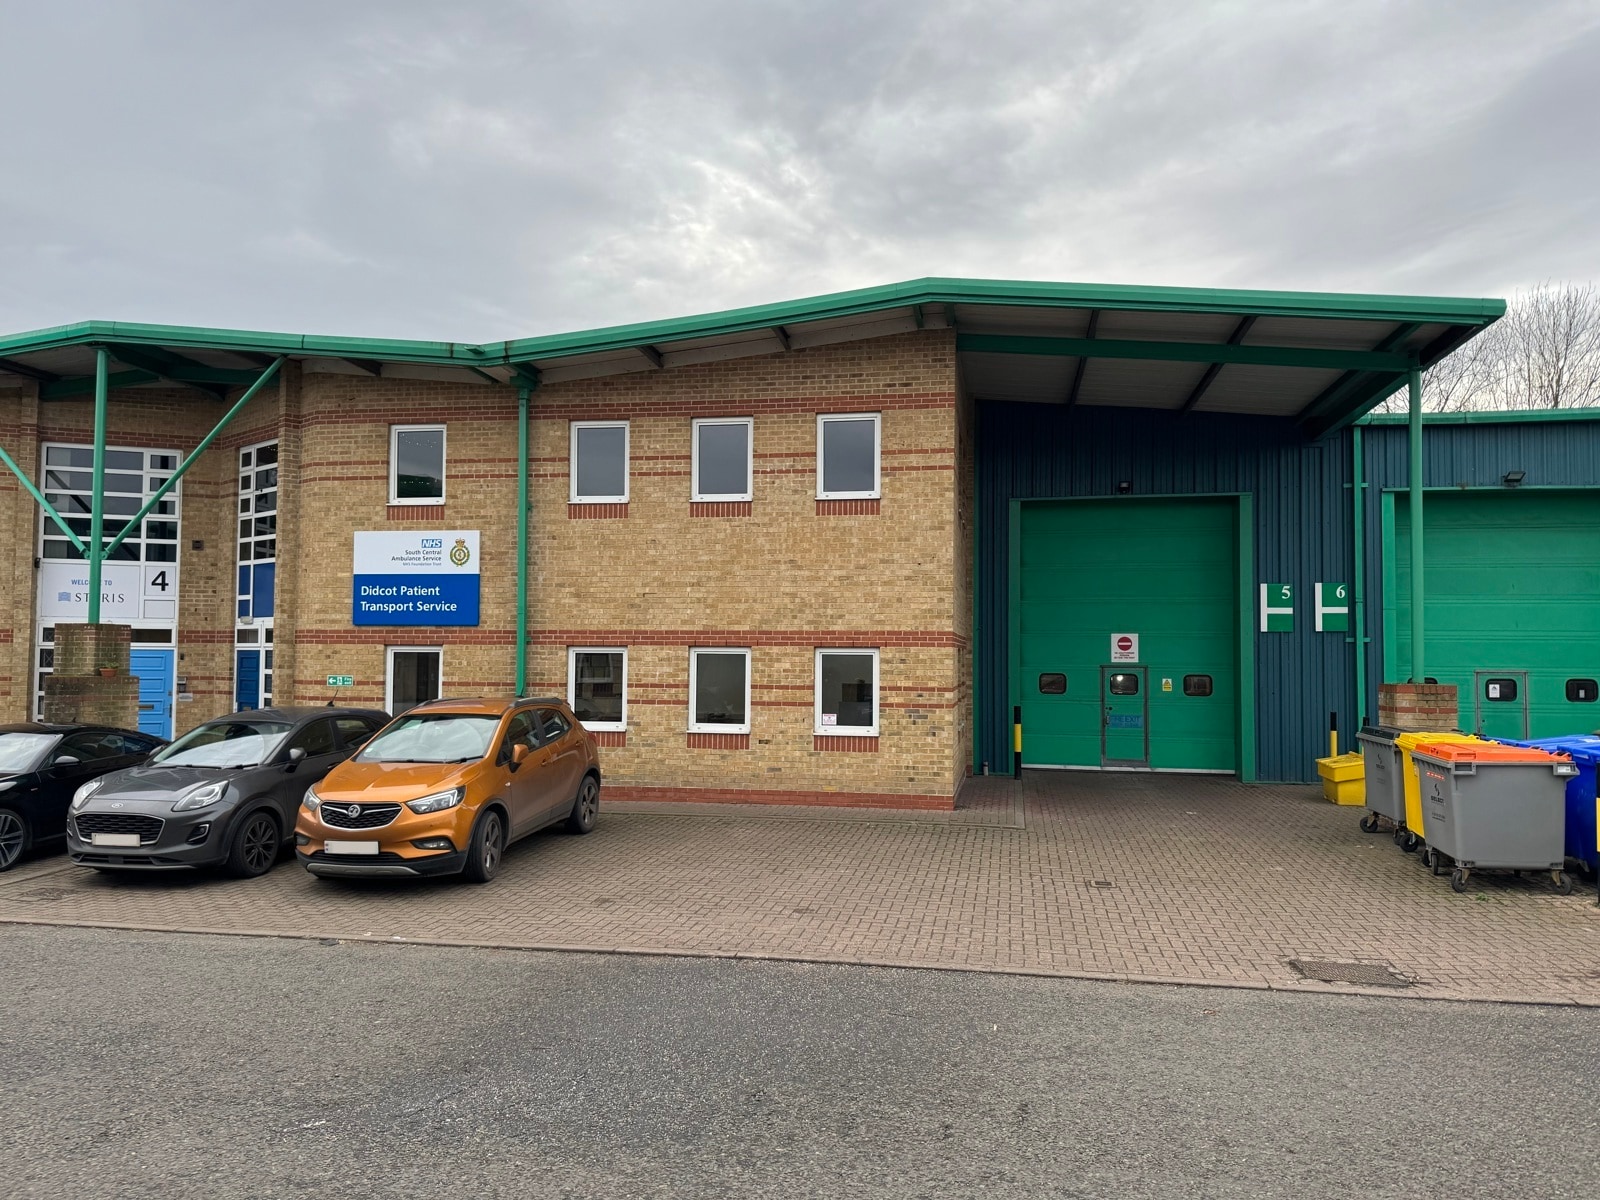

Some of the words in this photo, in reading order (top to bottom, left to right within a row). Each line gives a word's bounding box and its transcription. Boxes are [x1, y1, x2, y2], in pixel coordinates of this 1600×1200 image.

[422, 539, 442, 548] NHS
[151, 570, 169, 592] 4
[75, 592, 124, 603] STRIS
[361, 586, 398, 596] Didcot
[400, 586, 440, 596] Patient
[1282, 586, 1290, 599] 5
[1336, 584, 1346, 598] 6
[360, 602, 413, 614] Transport
[416, 601, 457, 612] Service
